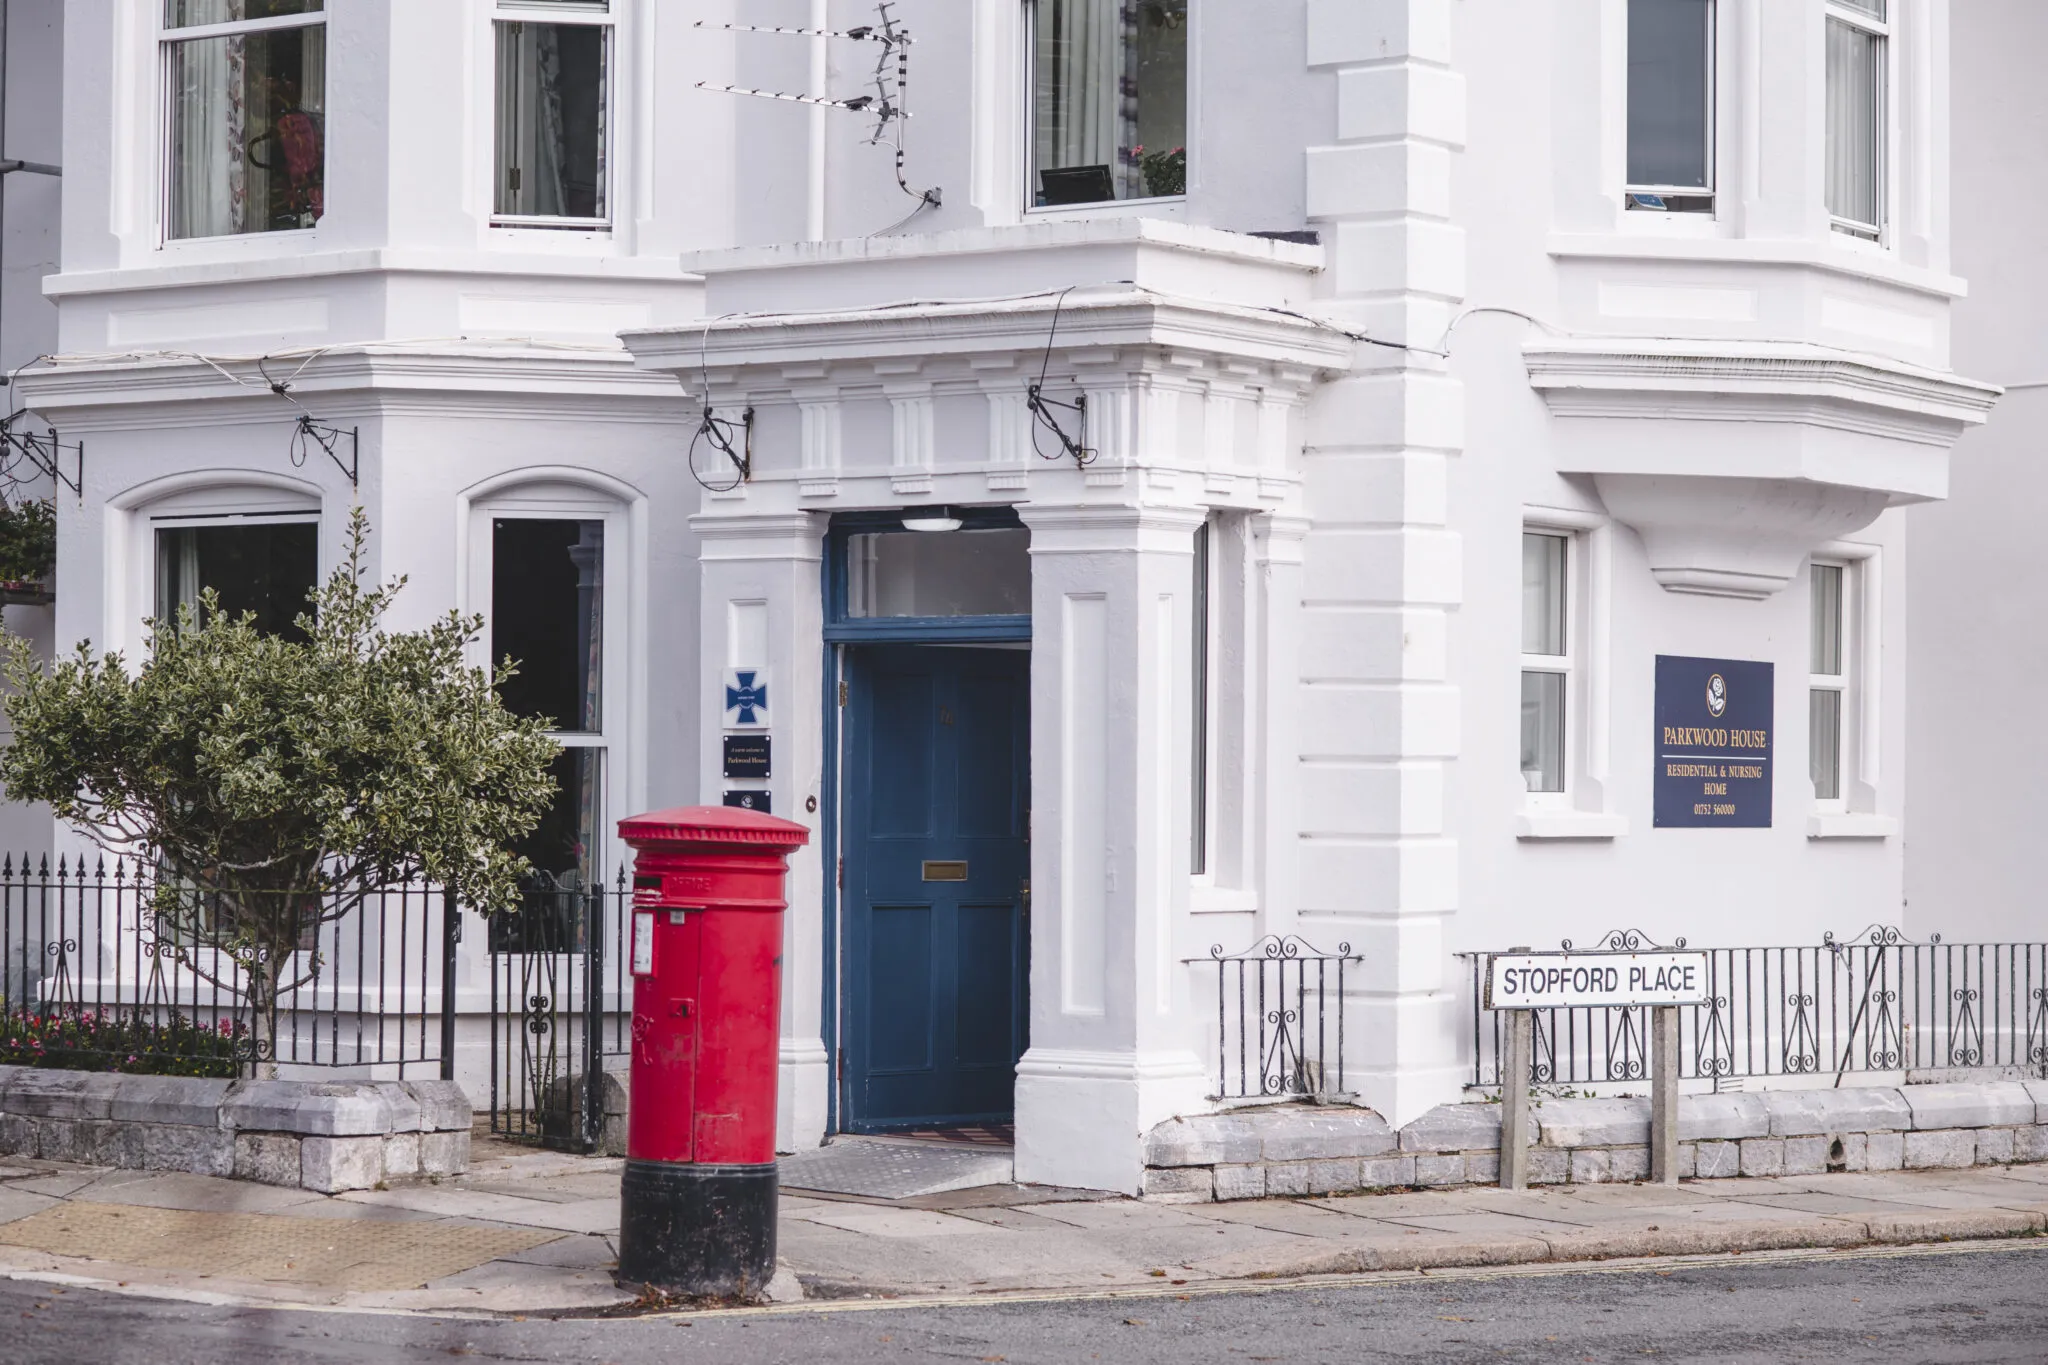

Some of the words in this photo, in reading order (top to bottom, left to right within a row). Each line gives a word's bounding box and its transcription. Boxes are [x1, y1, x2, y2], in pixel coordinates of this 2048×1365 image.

[1664, 727, 1727, 746] PARKWOOD
[1730, 729, 1766, 748] HOUSE
[1667, 764, 1717, 777] RESIDENTIAL
[1720, 765, 1726, 777] &
[1729, 766, 1762, 778] NURSING
[1703, 782, 1727, 795] HOME
[1694, 804, 1711, 815] 01752
[1503, 967, 1619, 995] STOPFORD
[1629, 965, 1696, 992] PLACE
